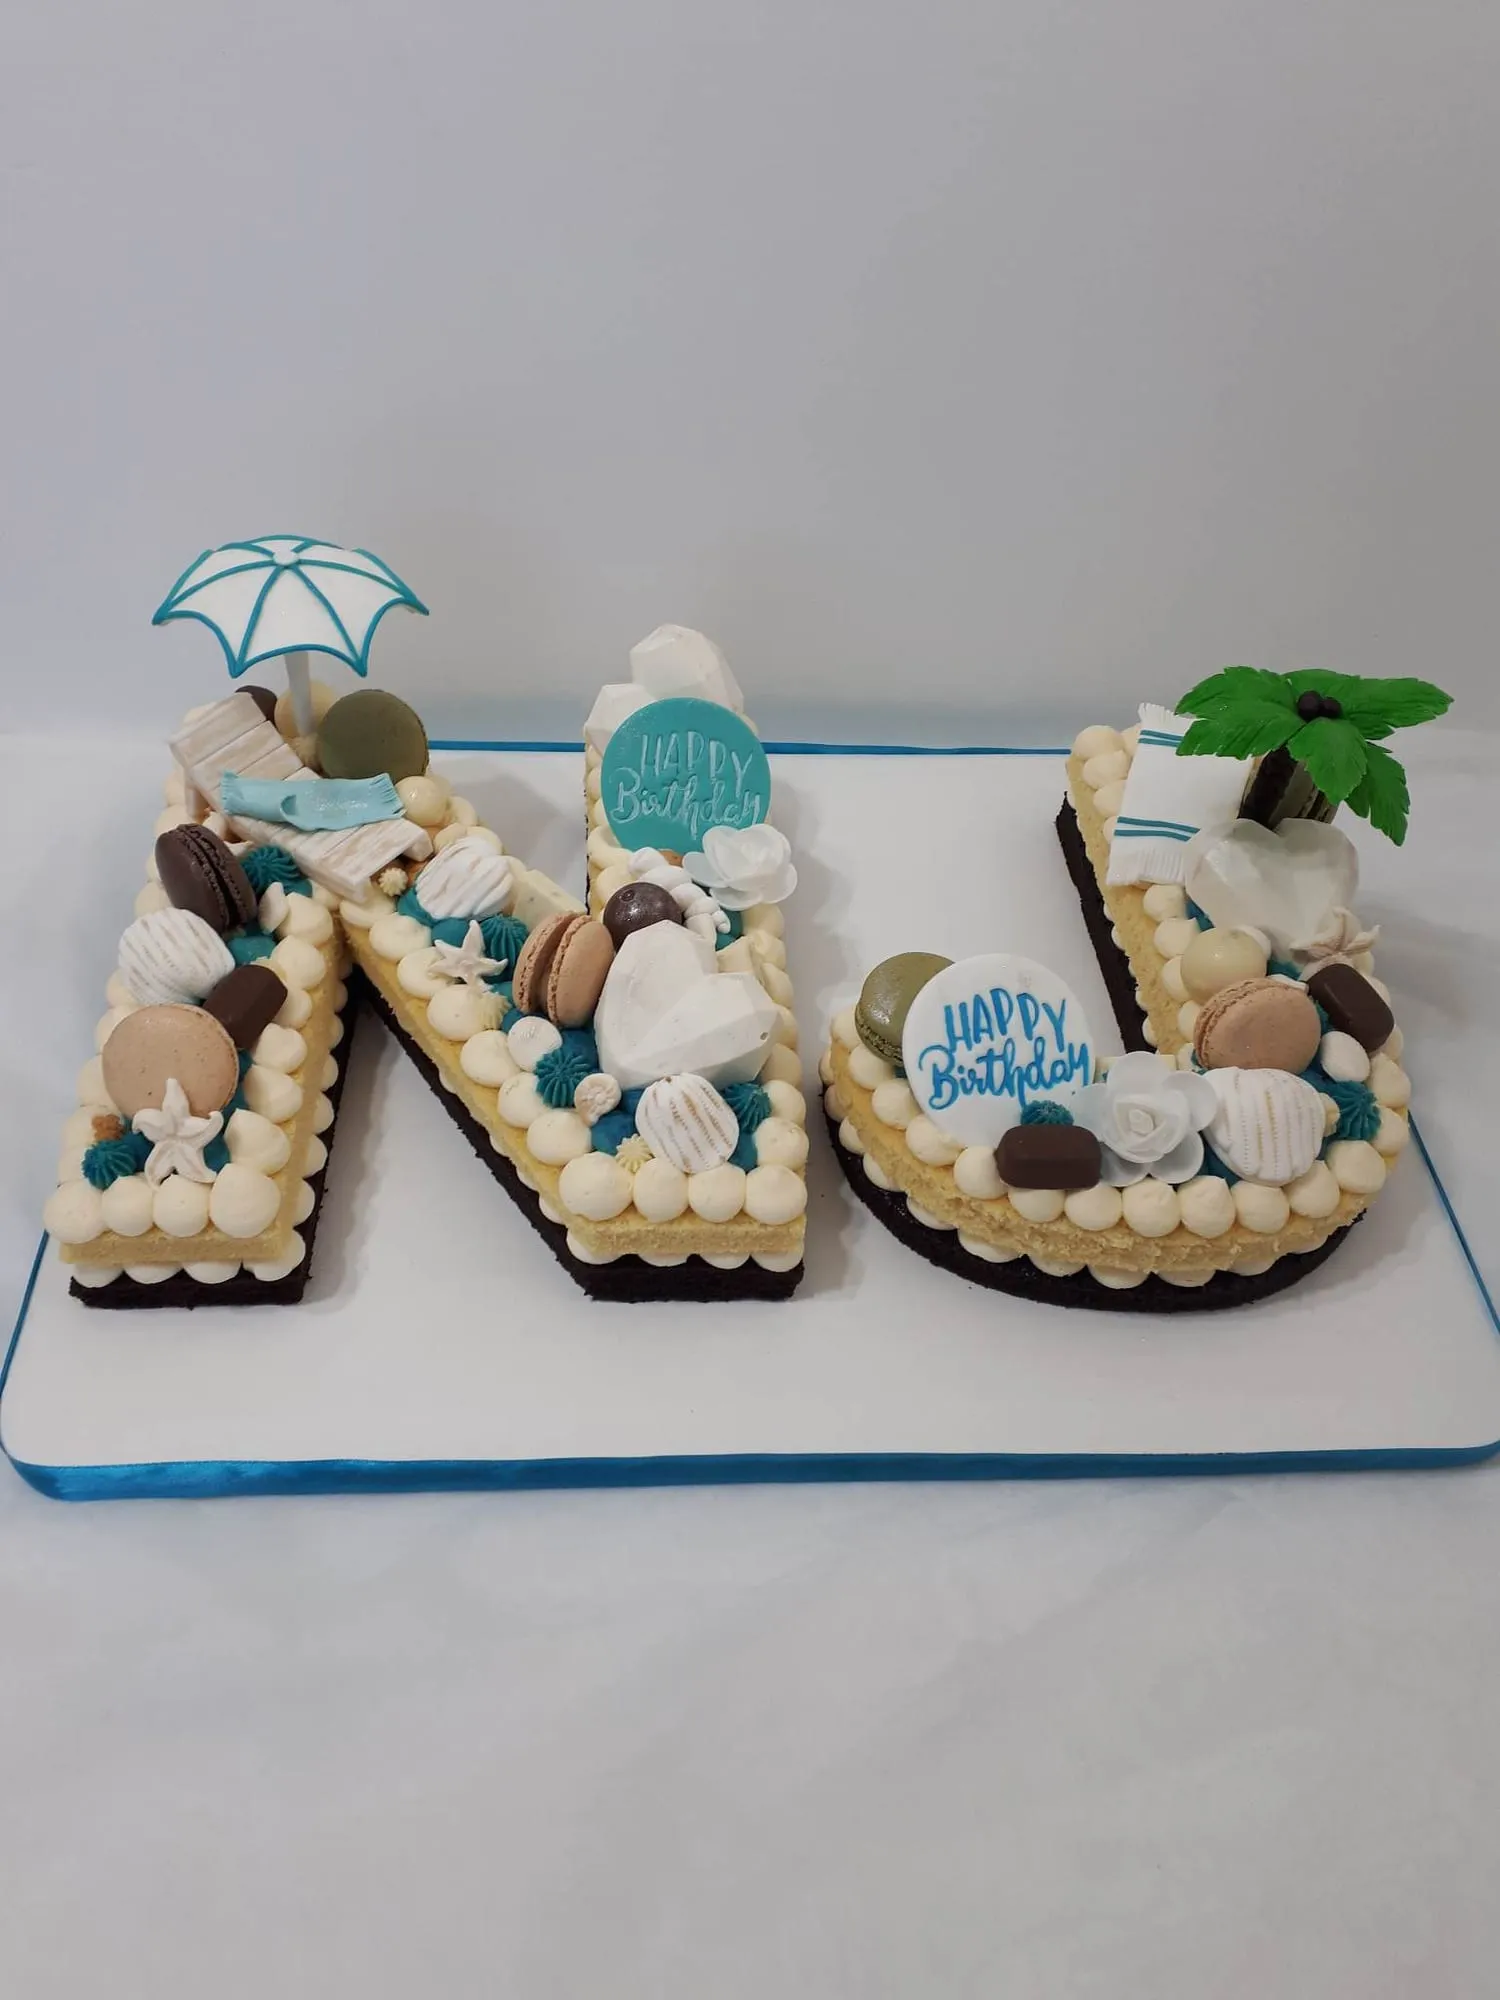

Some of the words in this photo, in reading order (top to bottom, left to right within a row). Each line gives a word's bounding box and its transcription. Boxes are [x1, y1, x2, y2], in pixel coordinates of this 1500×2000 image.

[641, 731, 752, 798] HAPPY
[609, 773, 760, 840] Birthday
[944, 988, 1066, 1053] HAPPY
[918, 1037, 1090, 1110] Birthday
